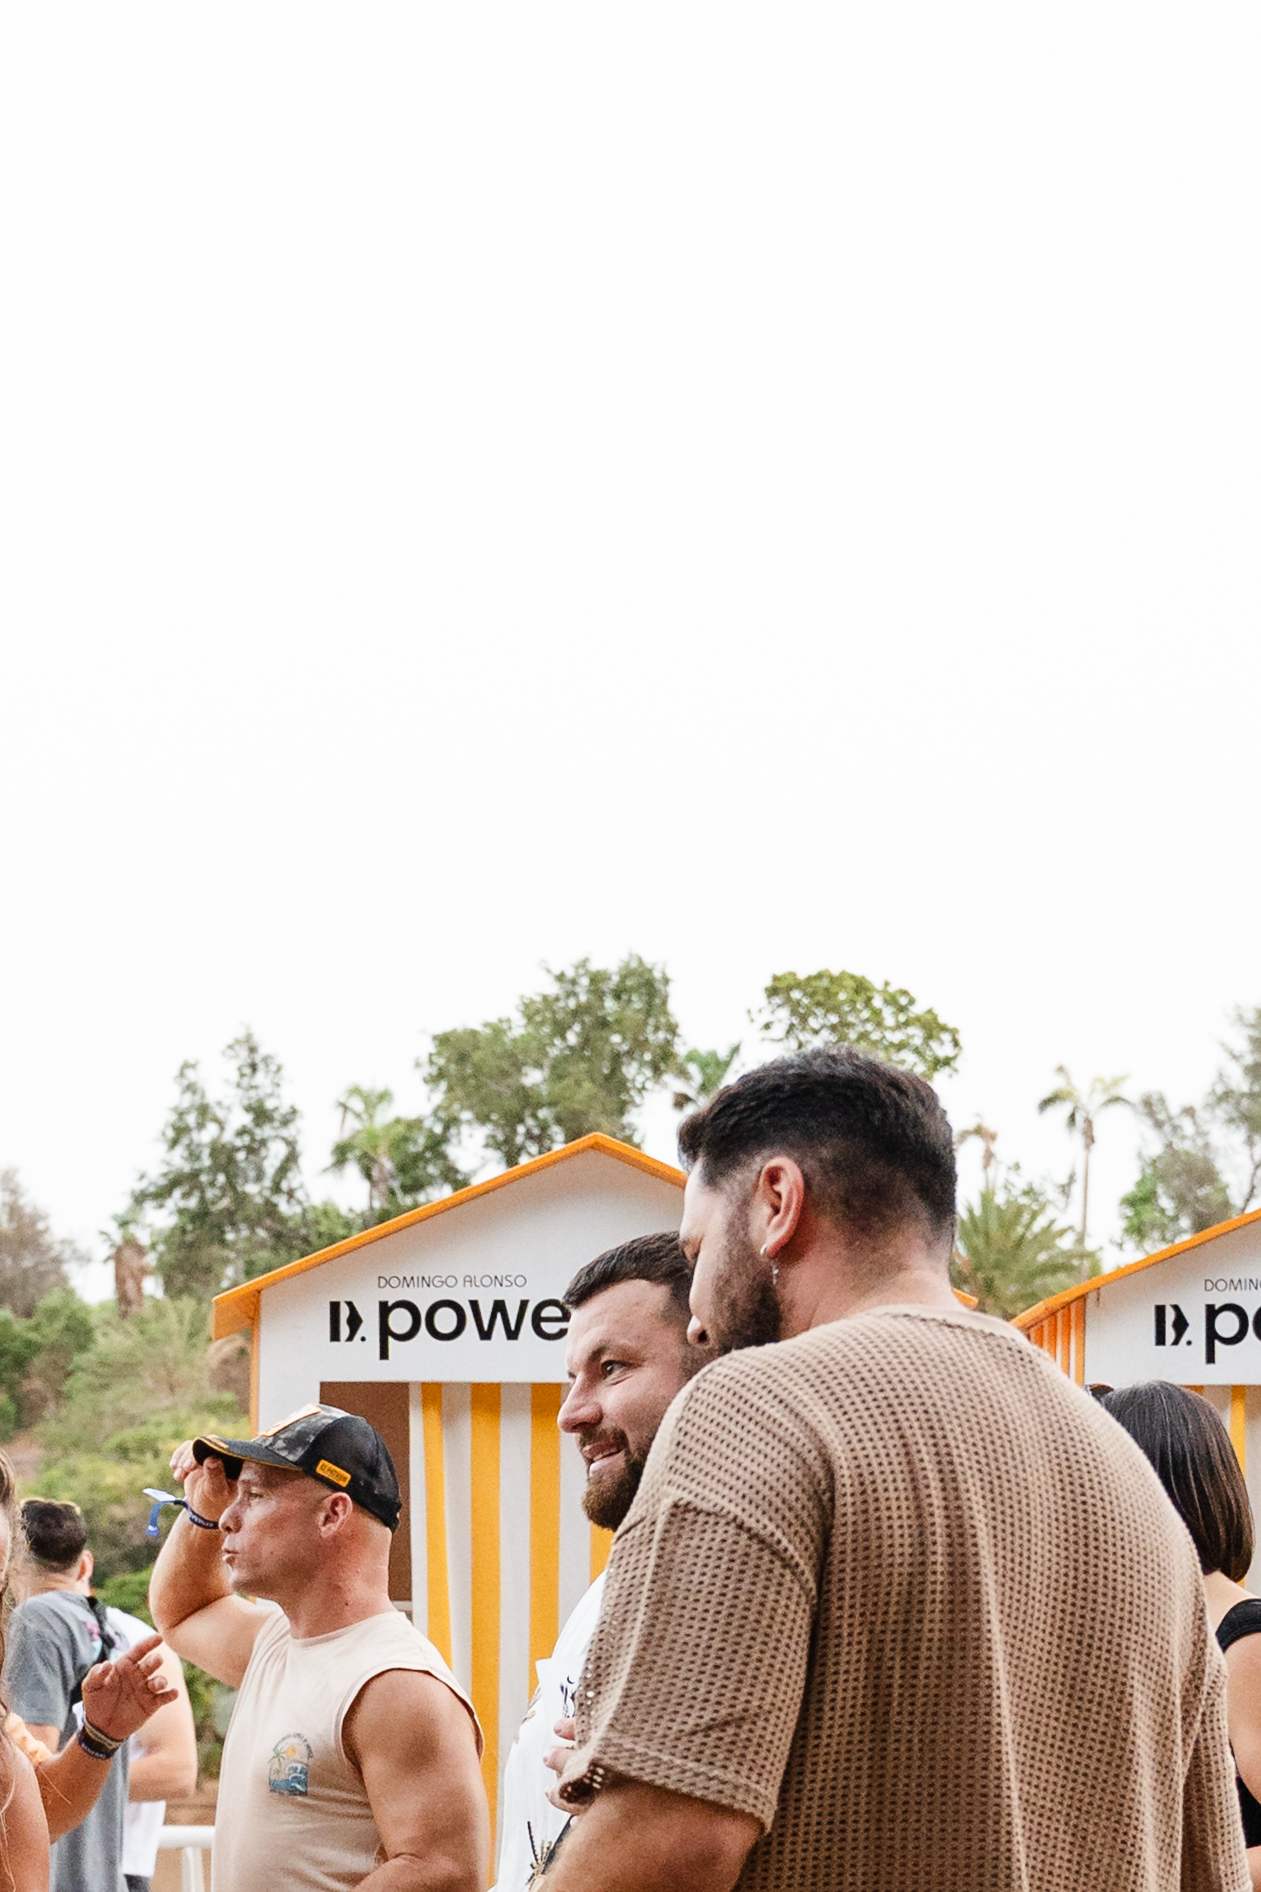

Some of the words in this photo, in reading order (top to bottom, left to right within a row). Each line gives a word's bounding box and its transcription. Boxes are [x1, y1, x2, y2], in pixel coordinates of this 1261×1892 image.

[377, 1275, 458, 1289] DOMINGO
[463, 1274, 527, 1288] ALONSO
[1204, 1278, 1261, 1292] DOMIN
